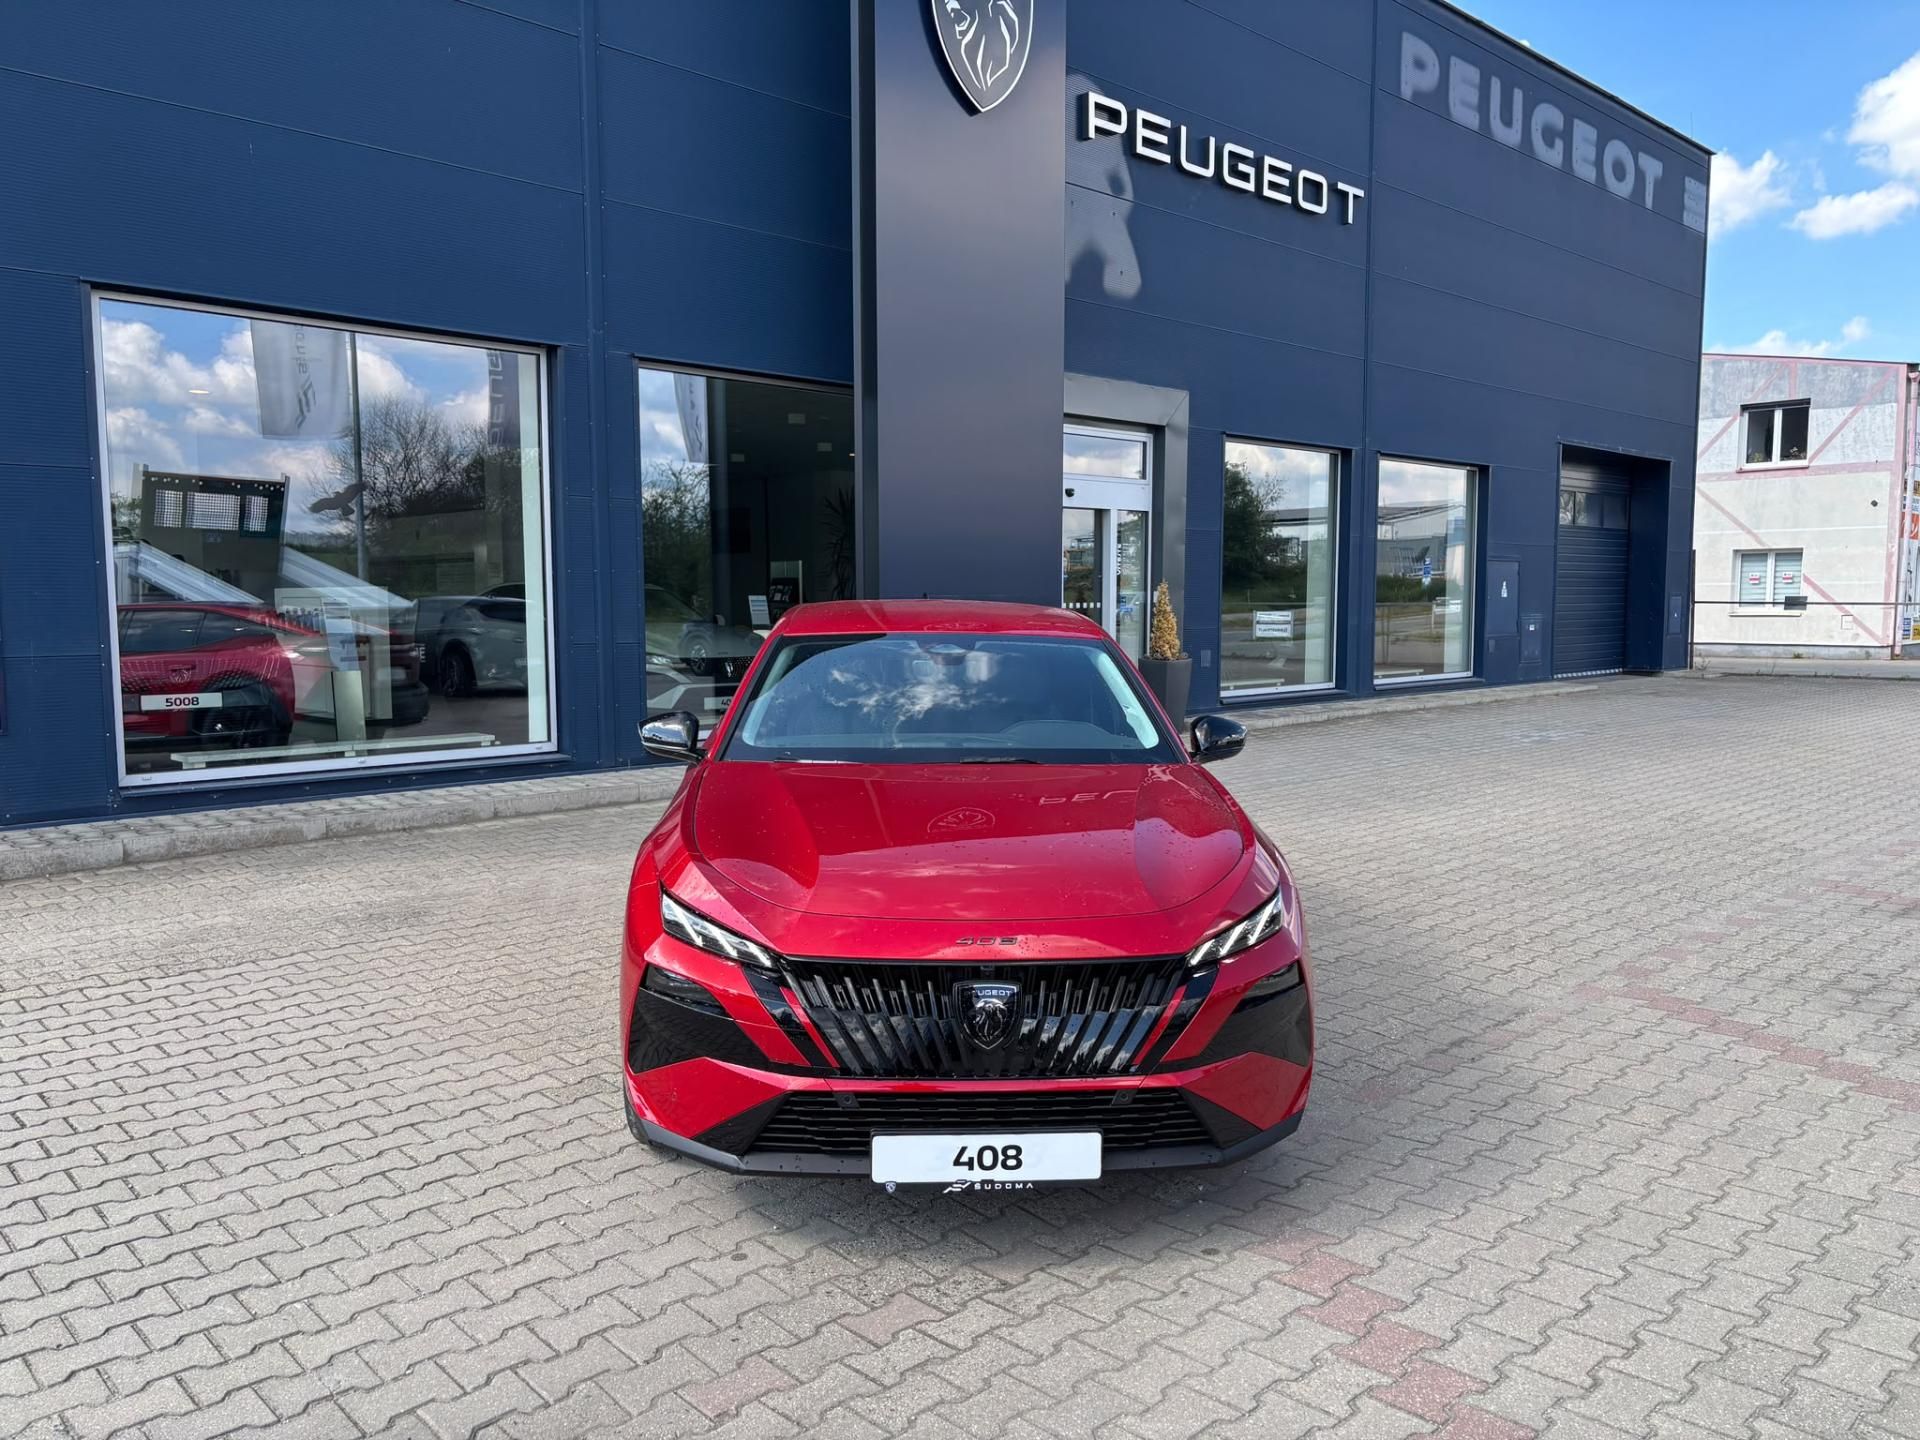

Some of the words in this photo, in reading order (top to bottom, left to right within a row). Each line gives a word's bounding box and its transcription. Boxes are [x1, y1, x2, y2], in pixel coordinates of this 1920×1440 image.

[1400, 30, 1664, 211] PEUGEOT
[1086, 90, 1366, 226] PEUGEOT
[165, 696, 200, 708] 5008
[955, 935, 1018, 946] 408
[952, 1144, 1024, 1172] 408
[973, 1181, 1034, 1190] SUDOMA
